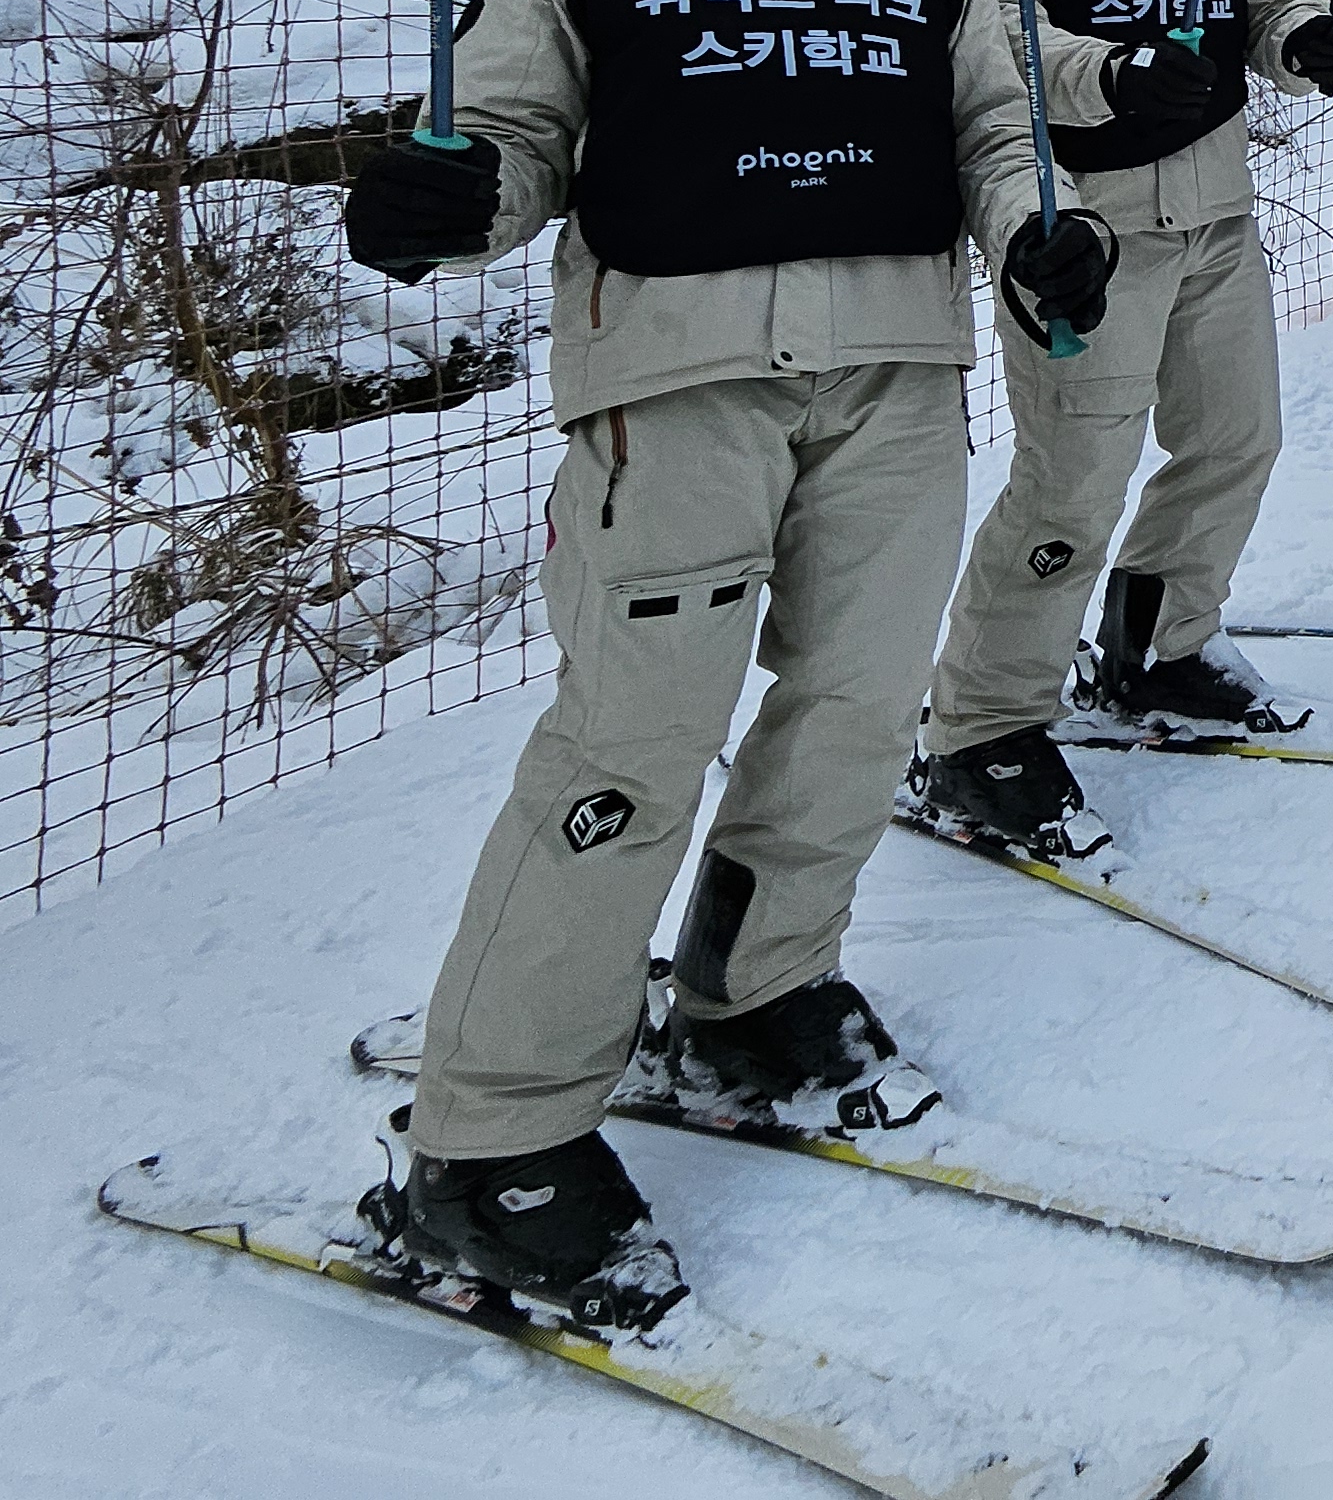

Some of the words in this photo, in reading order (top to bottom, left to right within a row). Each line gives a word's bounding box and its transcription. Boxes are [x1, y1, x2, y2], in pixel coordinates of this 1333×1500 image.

[681, 29, 908, 77] 스키학교
[736, 142, 874, 177] phoenix
[790, 176, 828, 189] PARK
